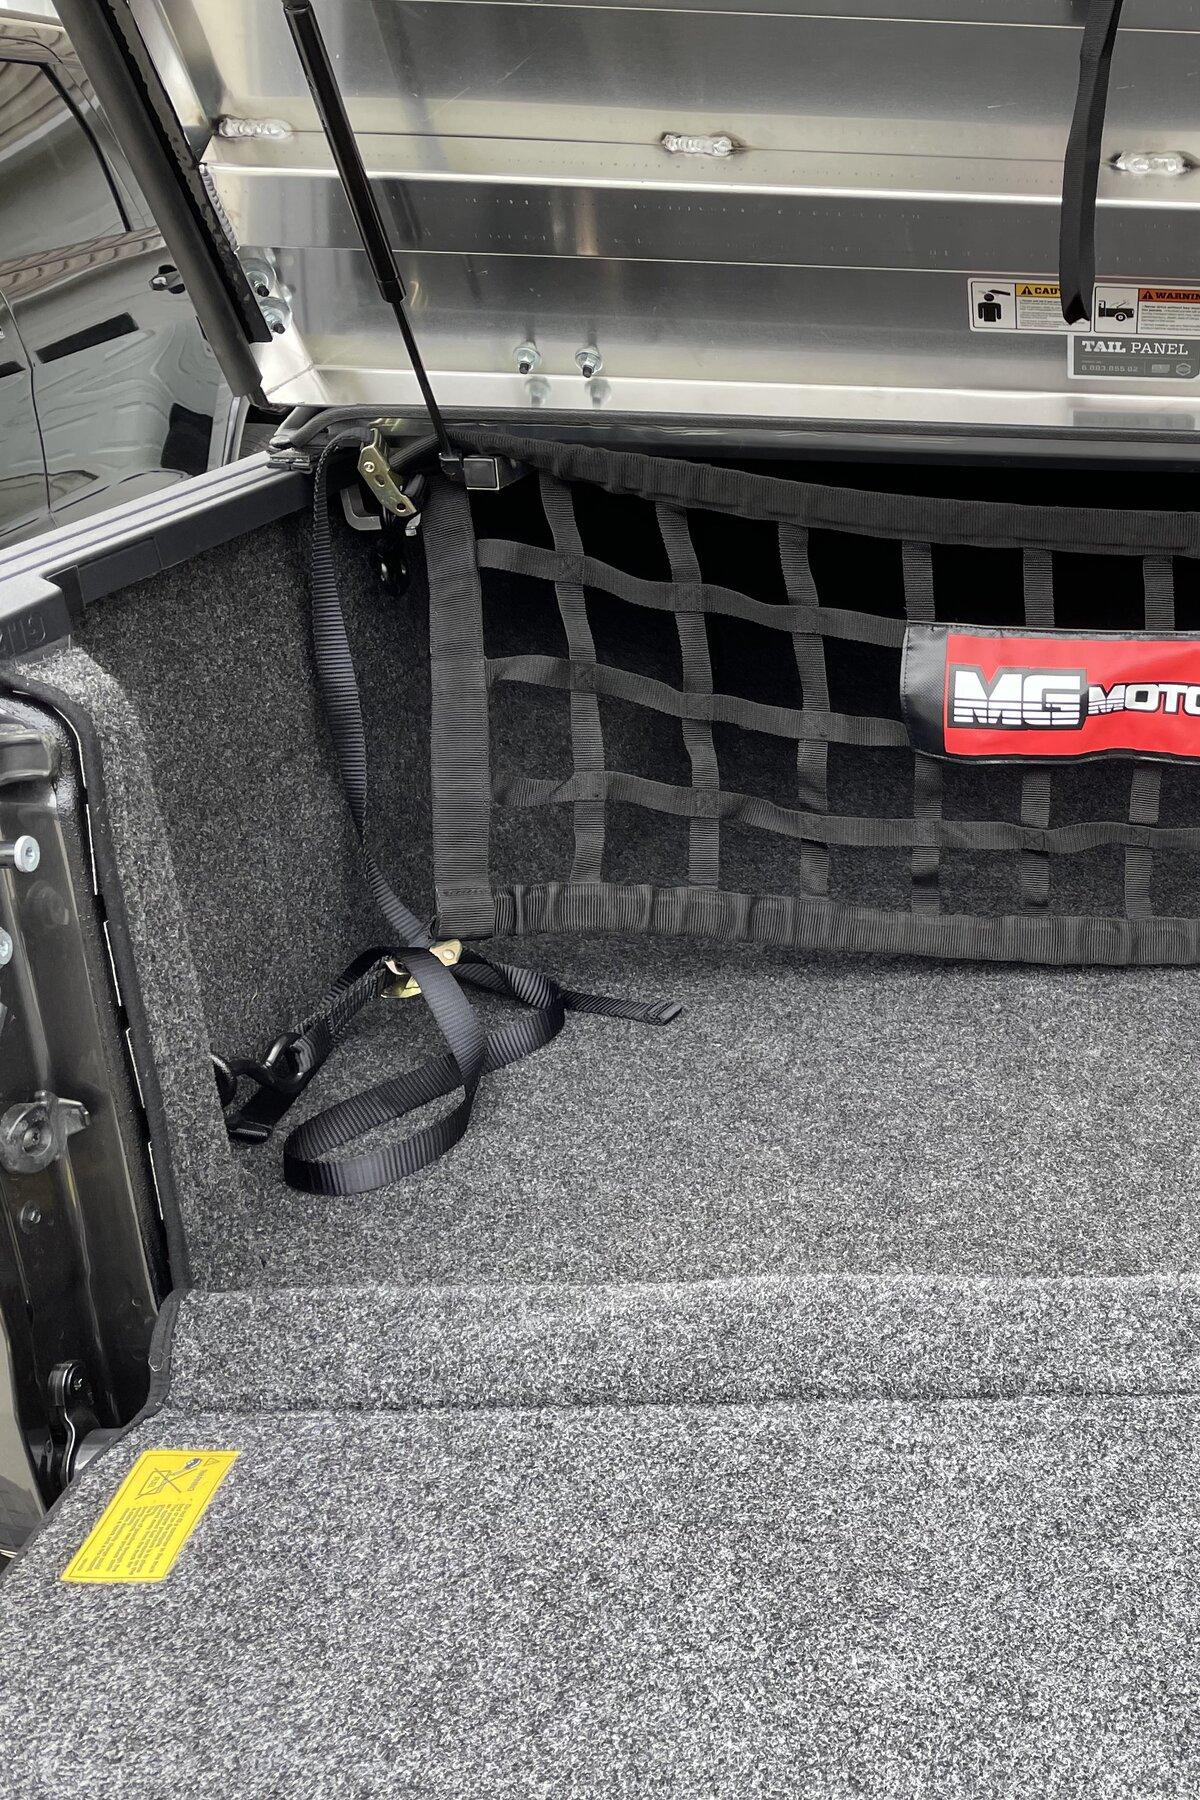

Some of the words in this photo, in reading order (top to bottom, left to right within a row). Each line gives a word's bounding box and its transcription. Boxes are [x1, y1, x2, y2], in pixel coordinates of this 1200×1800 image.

[1081, 340, 1126, 353] TAIL
[1130, 341, 1189, 355] PANEL
[951, 667, 1084, 728] MG
